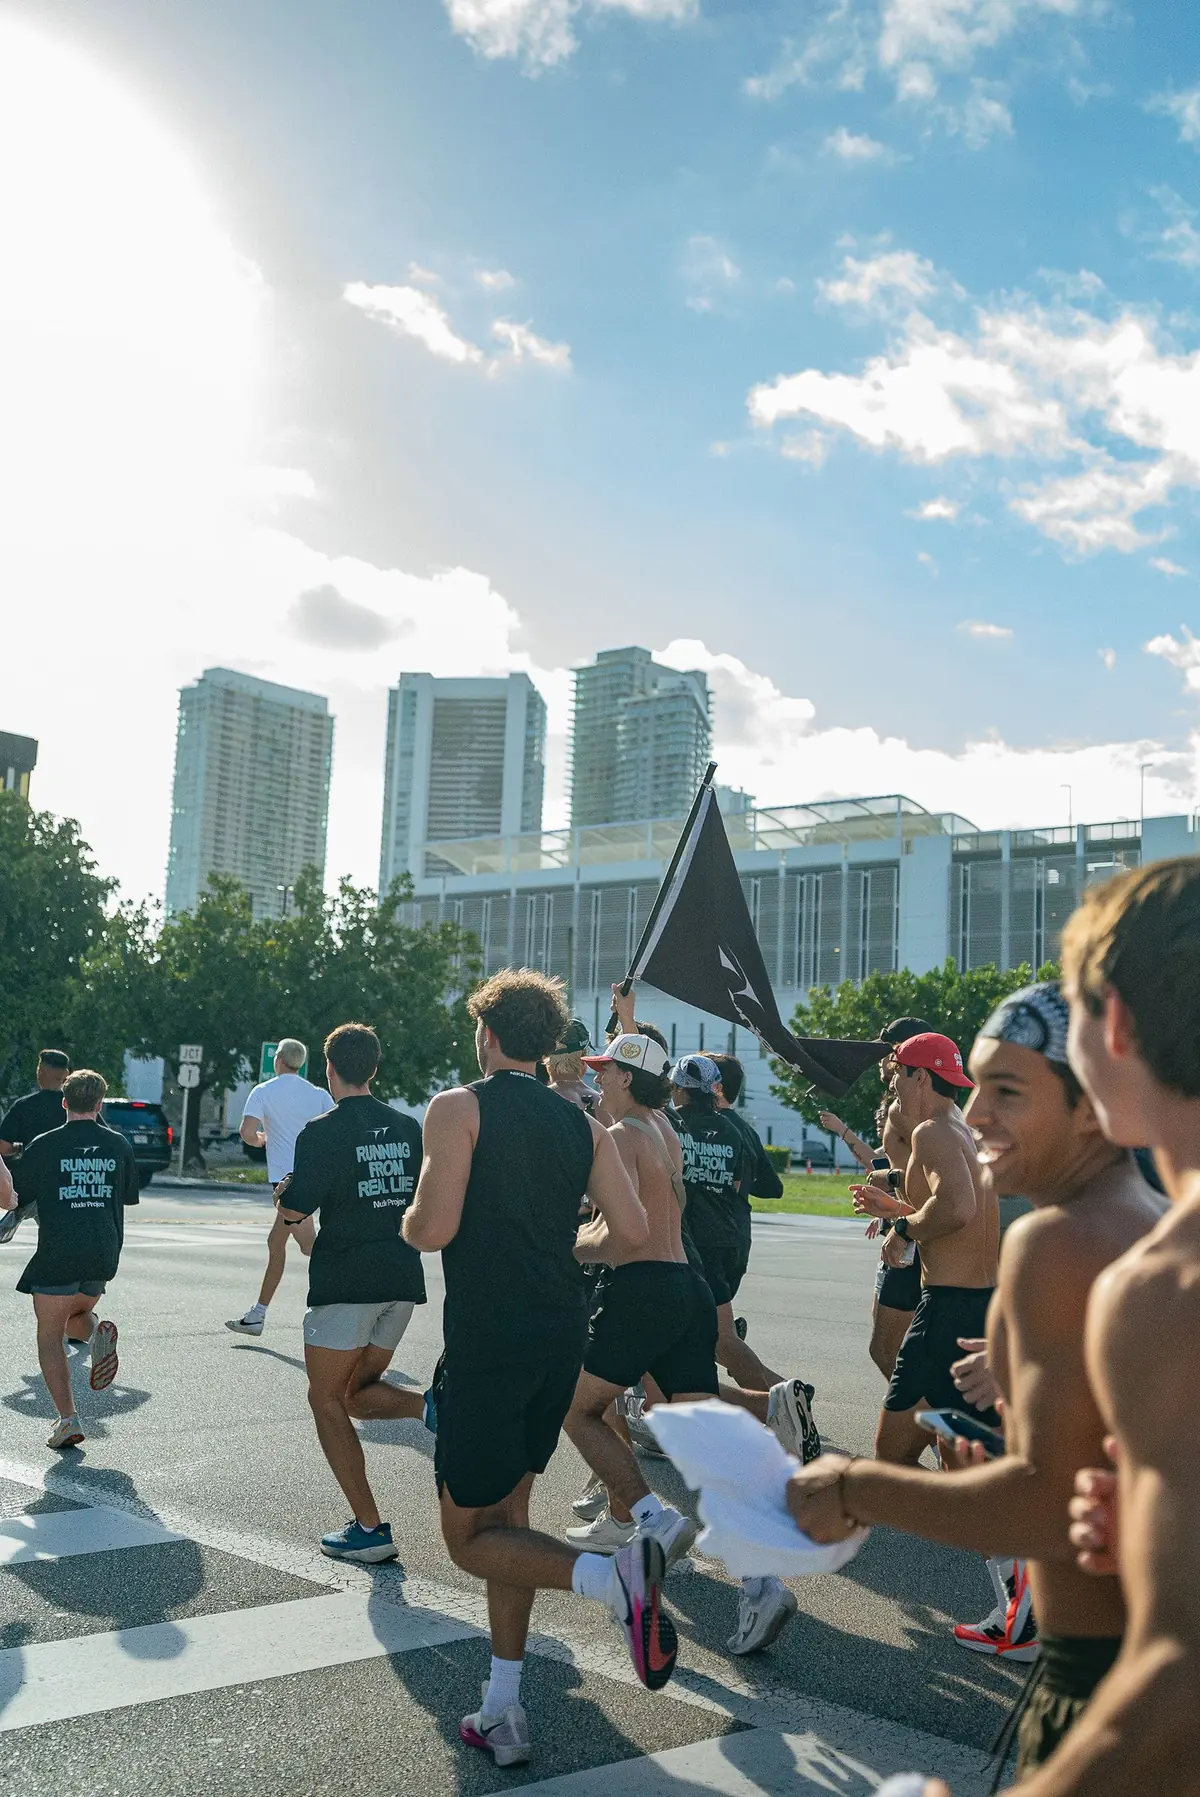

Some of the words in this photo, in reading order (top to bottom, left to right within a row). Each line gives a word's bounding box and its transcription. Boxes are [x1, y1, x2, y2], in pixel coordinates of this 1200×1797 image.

[183, 1048, 200, 1060] JCT
[356, 1142, 411, 1163] RUNNING
[692, 1142, 734, 1159] RUNNING
[60, 1158, 117, 1172] RUNNING
[368, 1159, 405, 1178] FROM
[699, 1155, 727, 1171] FROM
[71, 1171, 106, 1185] FROM
[59, 1185, 91, 1201] REAL
[91, 1184, 114, 1198] LIFE
